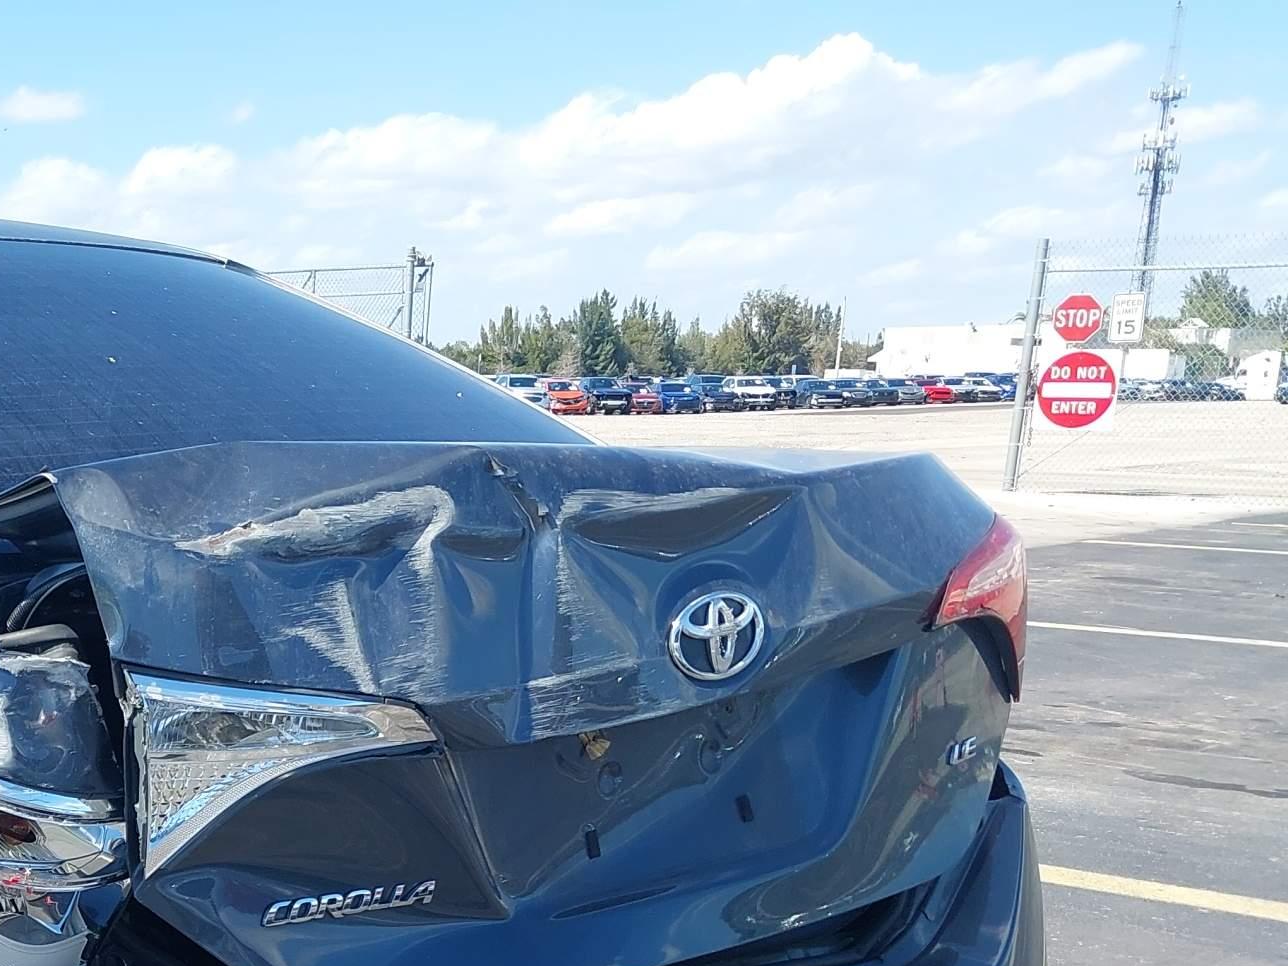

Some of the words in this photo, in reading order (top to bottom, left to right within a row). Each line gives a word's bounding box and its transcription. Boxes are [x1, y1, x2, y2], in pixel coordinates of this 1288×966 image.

[1115, 299, 1143, 307] SPEED
[1055, 308, 1101, 328] STOP
[1117, 320, 1136, 335] 15
[1050, 366, 1071, 380] DO
[1076, 366, 1108, 380] NOT
[1050, 401, 1097, 415] ENTER
[949, 736, 977, 765] LE
[262, 879, 437, 928] COROLLA
